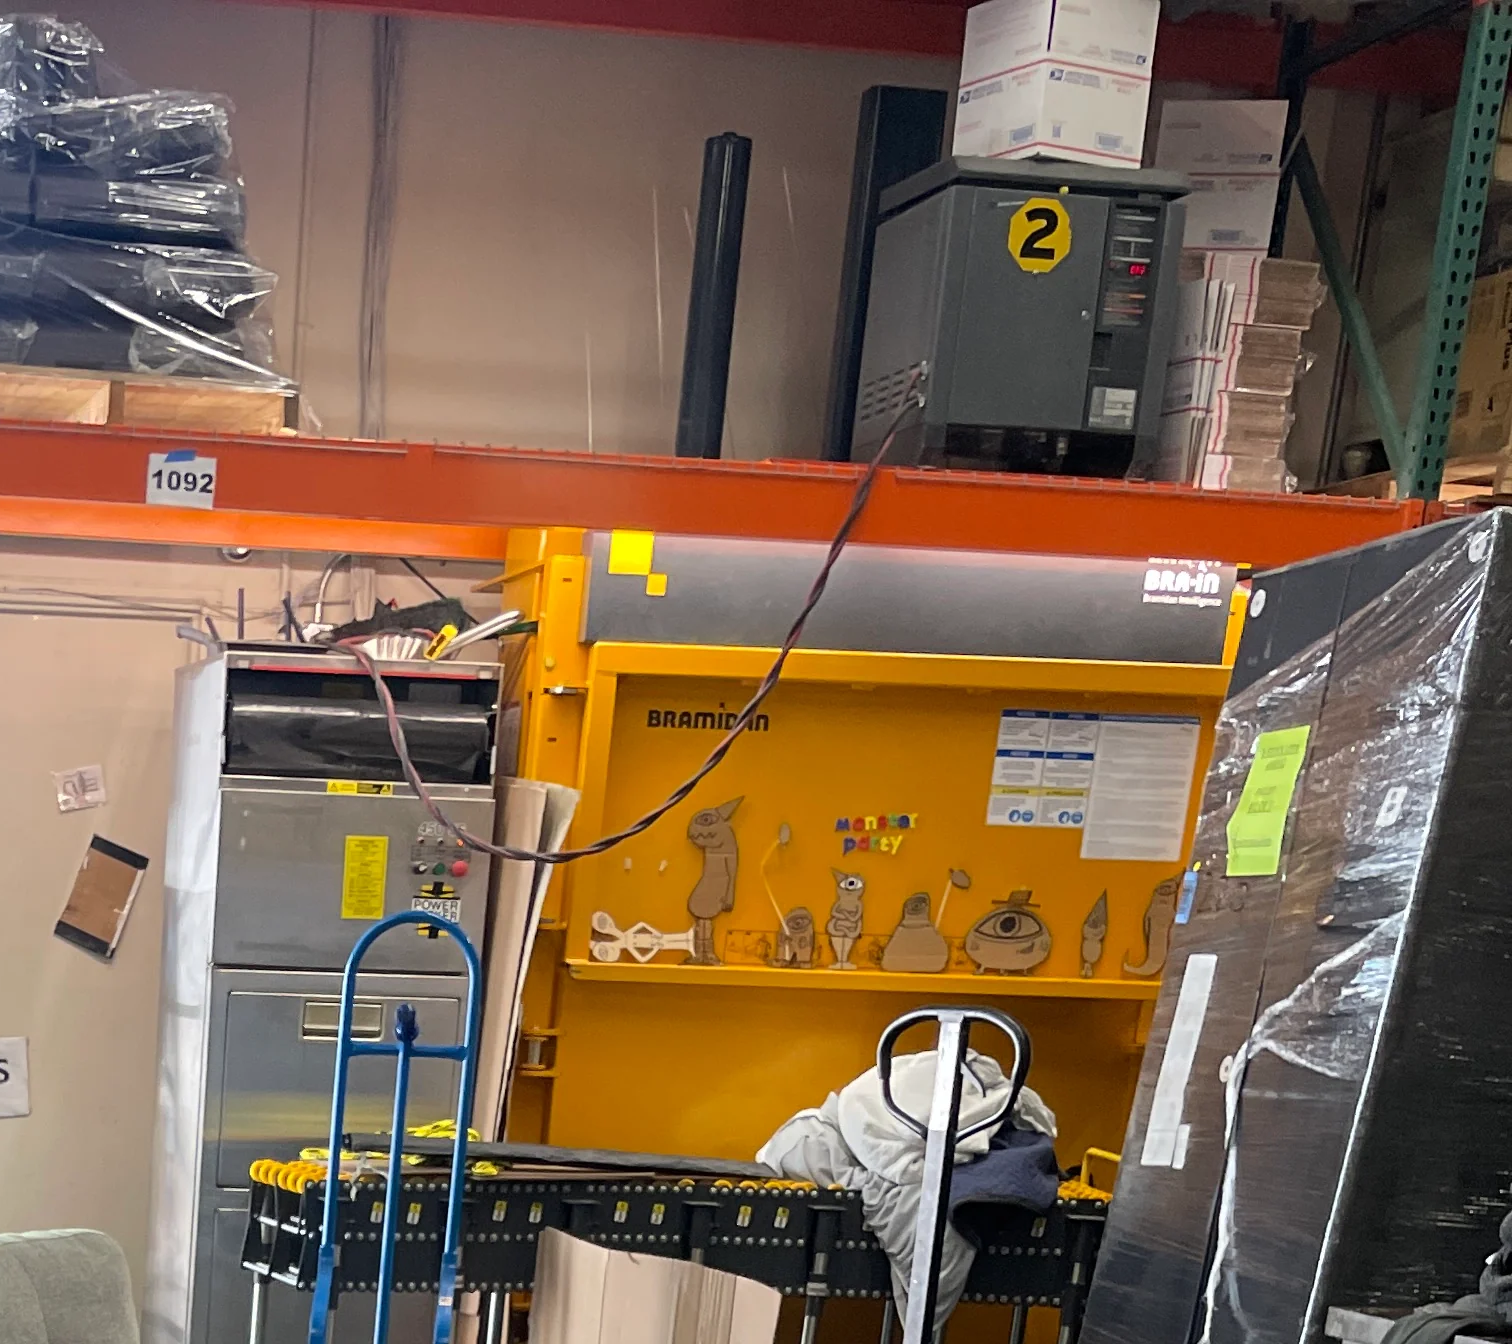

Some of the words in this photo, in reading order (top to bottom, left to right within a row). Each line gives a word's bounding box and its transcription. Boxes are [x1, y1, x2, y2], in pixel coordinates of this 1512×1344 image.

[1020, 208, 1059, 260] 2
[152, 469, 214, 494] 1092
[414, 900, 458, 913] POWER
